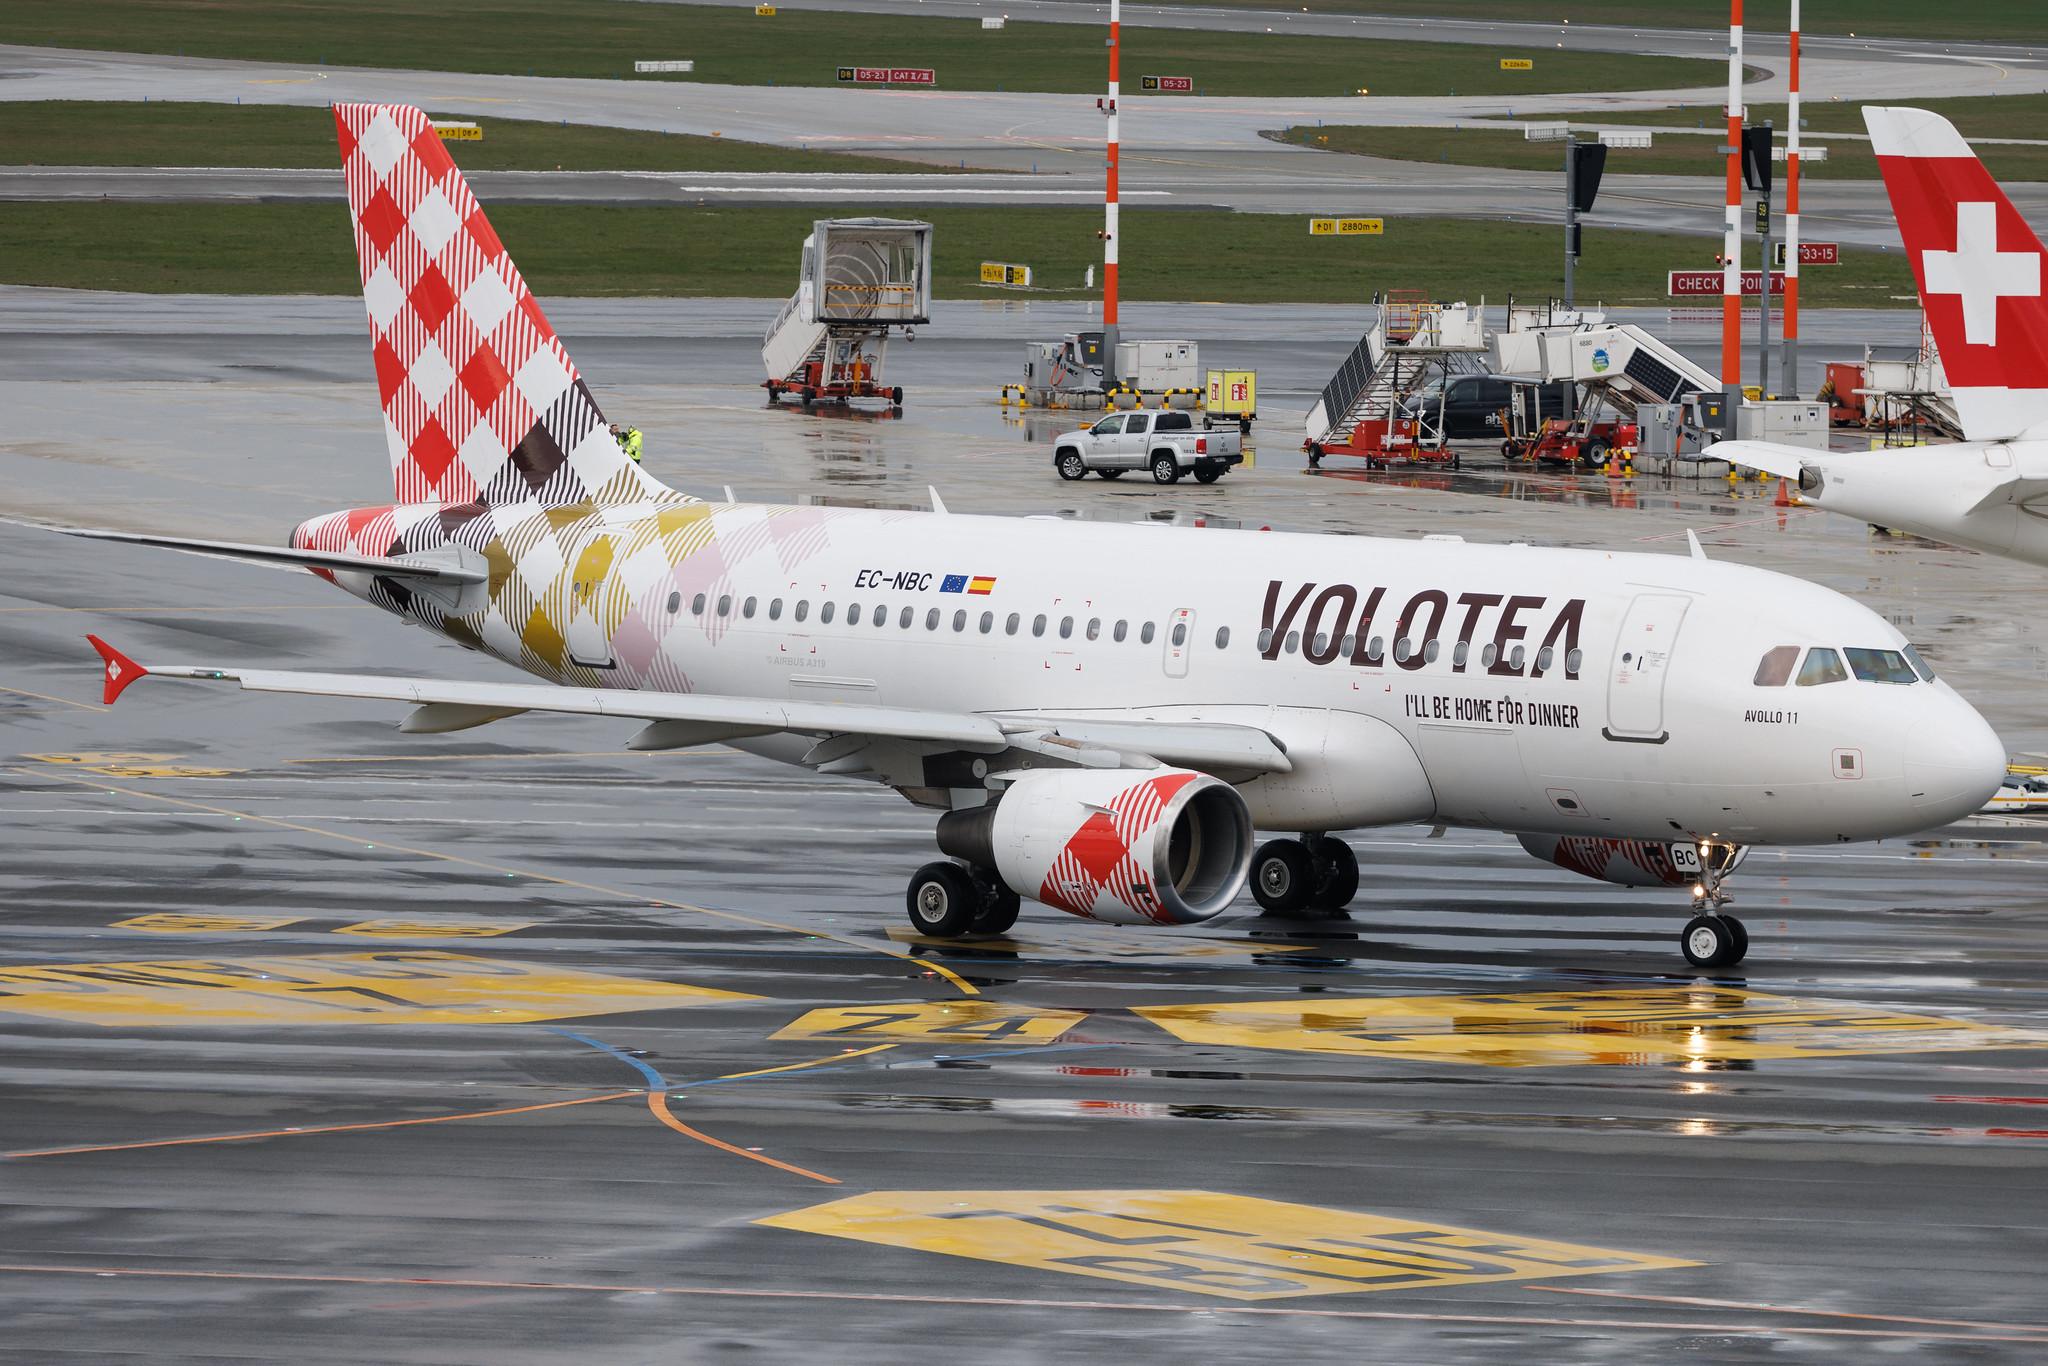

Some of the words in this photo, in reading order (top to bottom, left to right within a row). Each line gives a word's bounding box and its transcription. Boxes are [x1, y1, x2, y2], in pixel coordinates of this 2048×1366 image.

[860, 71, 885, 79] 05-23
[894, 72, 908, 80] CAT
[1163, 80, 1187, 88] 05-23
[1342, 223, 1370, 231] 2880m
[1803, 248, 1833, 260] 33-15
[1678, 278, 1720, 290] CHECK
[1740, 278, 1775, 290] POIT
[854, 569, 933, 592] EC-NBC
[1260, 580, 1586, 681] VOLOTEA
[773, 656, 805, 667] AIRBUS
[1405, 694, 1429, 718] I'LL
[1433, 696, 1450, 719] BE
[1455, 697, 1493, 722] HOME
[1497, 700, 1524, 724] FOR
[1528, 702, 1579, 729] DINNER
[1744, 709, 1783, 724] AVOLLO
[1786, 711, 1798, 724] 11
[1674, 849, 1696, 866] BC
[0, 955, 530, 997] ORANG
[1044, 1230, 1643, 1293] BLUE
